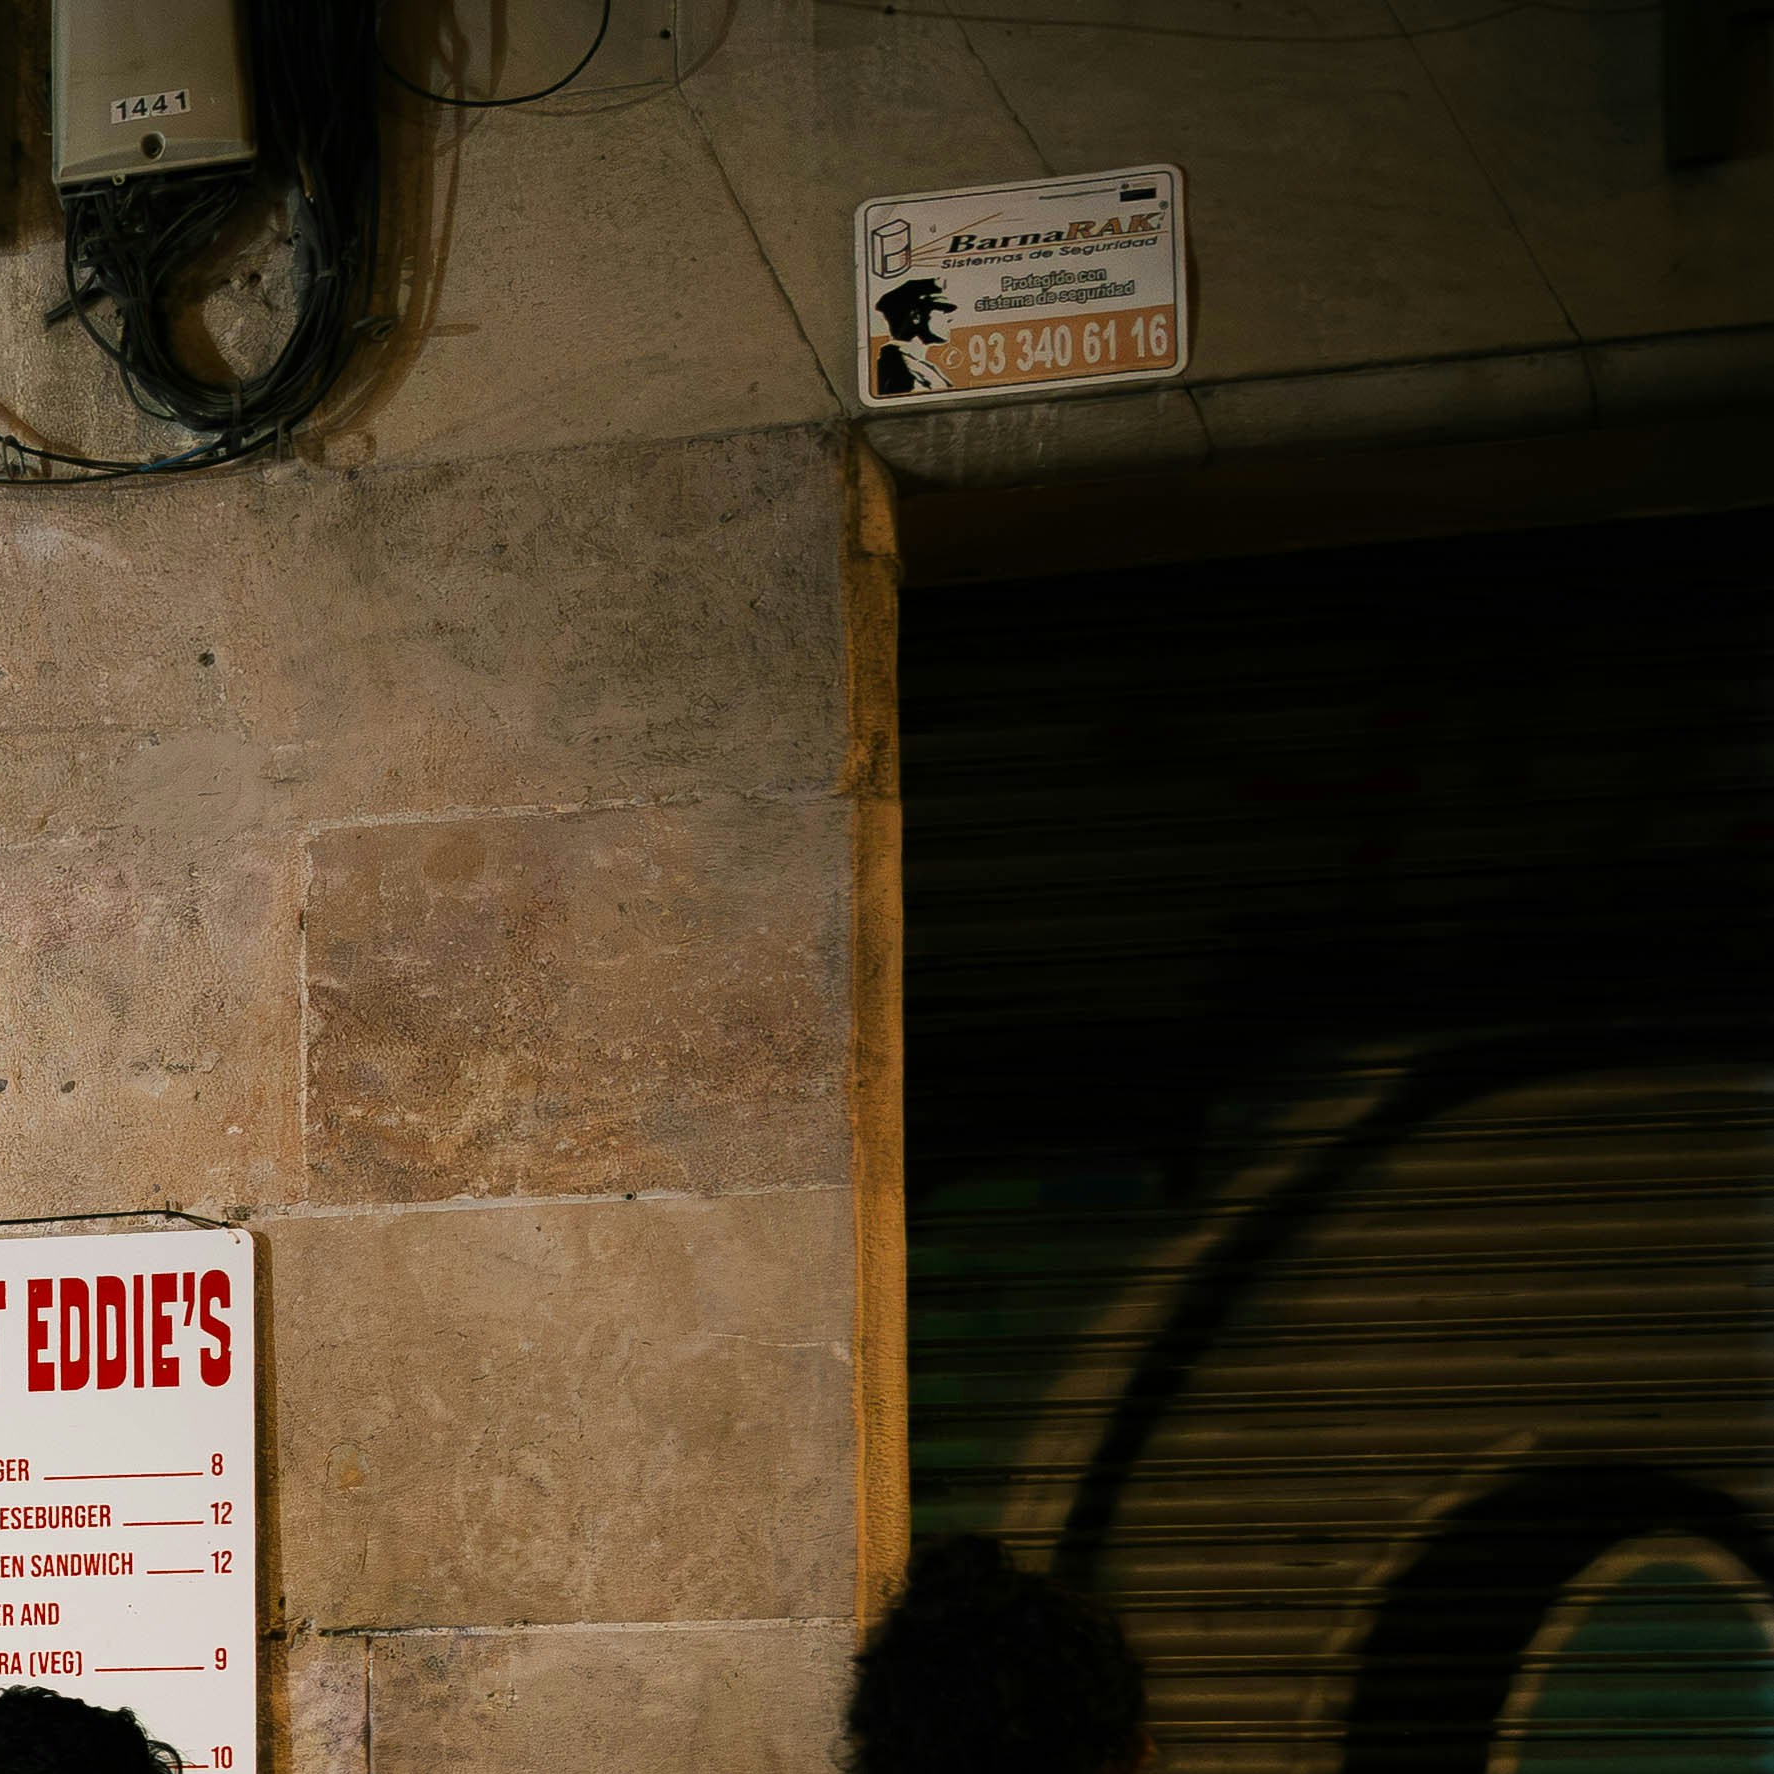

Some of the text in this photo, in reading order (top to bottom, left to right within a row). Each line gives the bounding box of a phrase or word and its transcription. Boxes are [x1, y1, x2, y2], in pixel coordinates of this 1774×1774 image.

[116, 91, 189, 121] 1441
[941, 235, 1158, 269] Sistemas de Seguridad
[1001, 267, 1107, 293] Protegido con
[974, 280, 1135, 312] sistema de seguridad
[967, 313, 1169, 377] 93 340 61 16
[27, 1270, 232, 1392] EDDIE'S
[211, 1453, 224, 1477] 8
[211, 1502, 233, 1527] 12
[31, 1552, 134, 1578] SANDWICH
[211, 1551, 233, 1576] 12
[20, 1603, 60, 1627] AND
[29, 1650, 83, 1678] (VEG)
[214, 1648, 228, 1672] 9
[211, 1746, 233, 1771] 10
